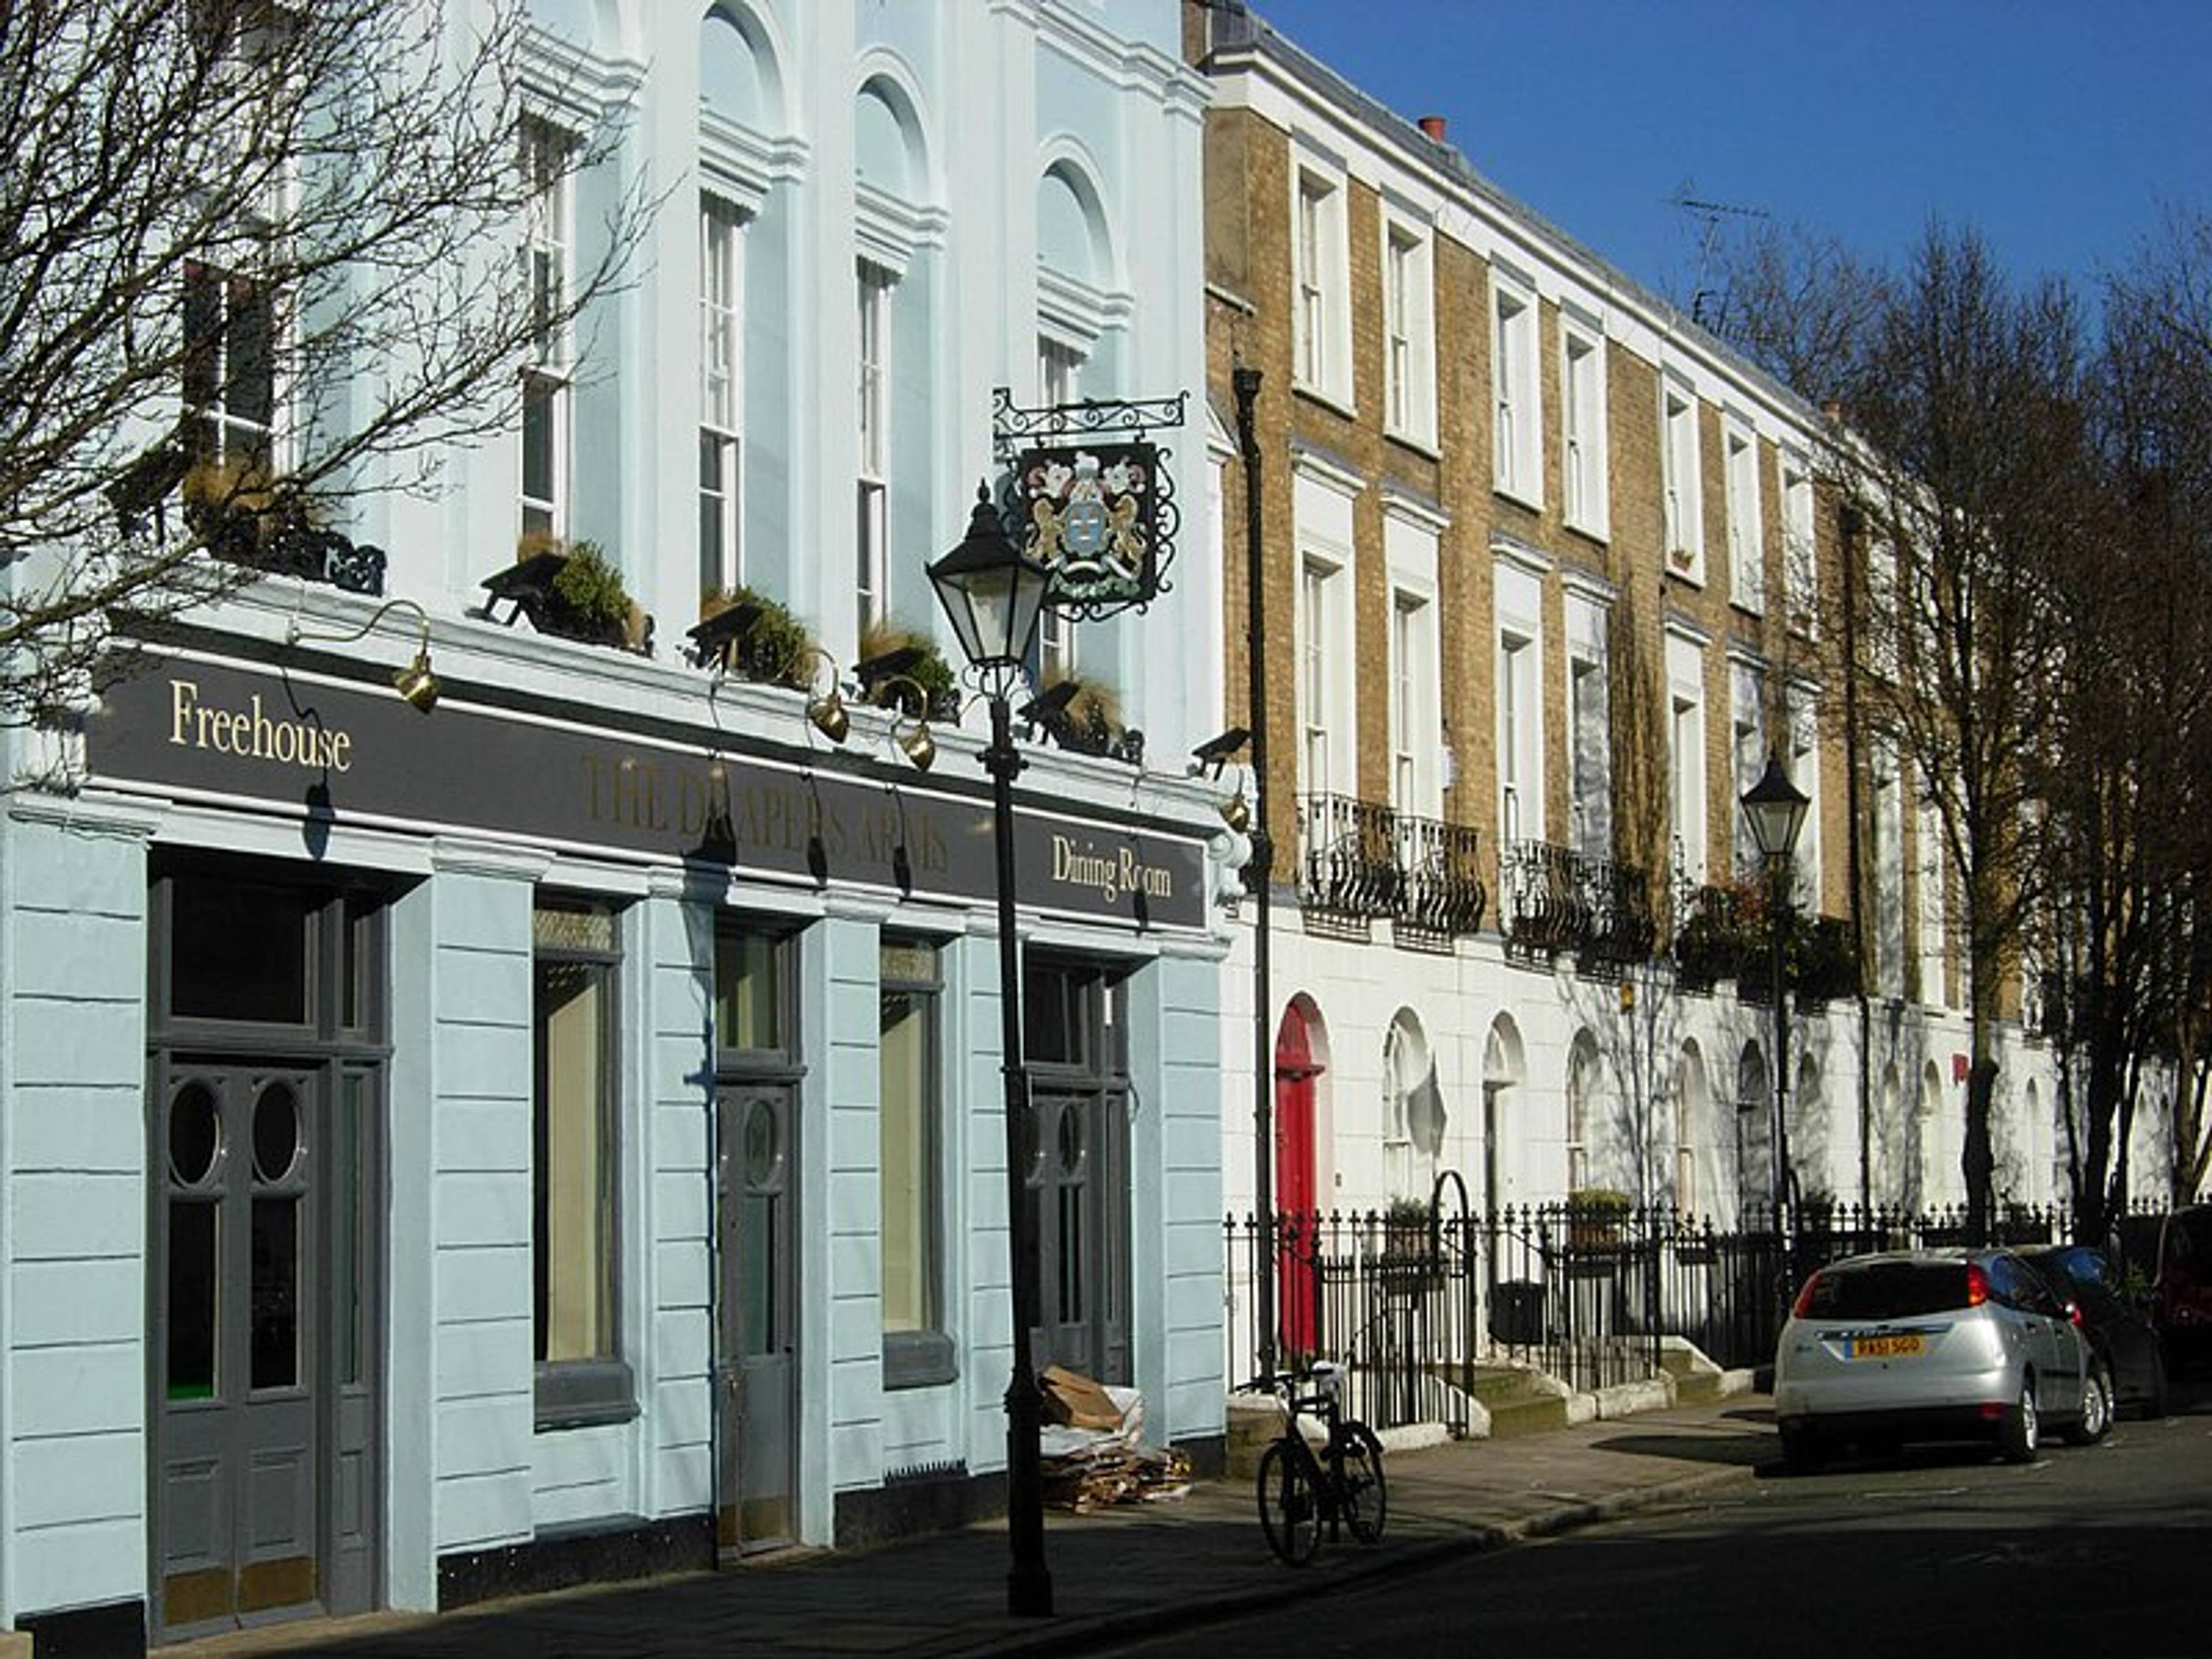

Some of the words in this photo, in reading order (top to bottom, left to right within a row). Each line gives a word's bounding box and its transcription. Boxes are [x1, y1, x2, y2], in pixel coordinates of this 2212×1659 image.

[169, 680, 351, 772] Freehouse
[581, 752, 668, 831] THE
[1052, 835, 1117, 903] Dining
[1119, 847, 1171, 897] Room
